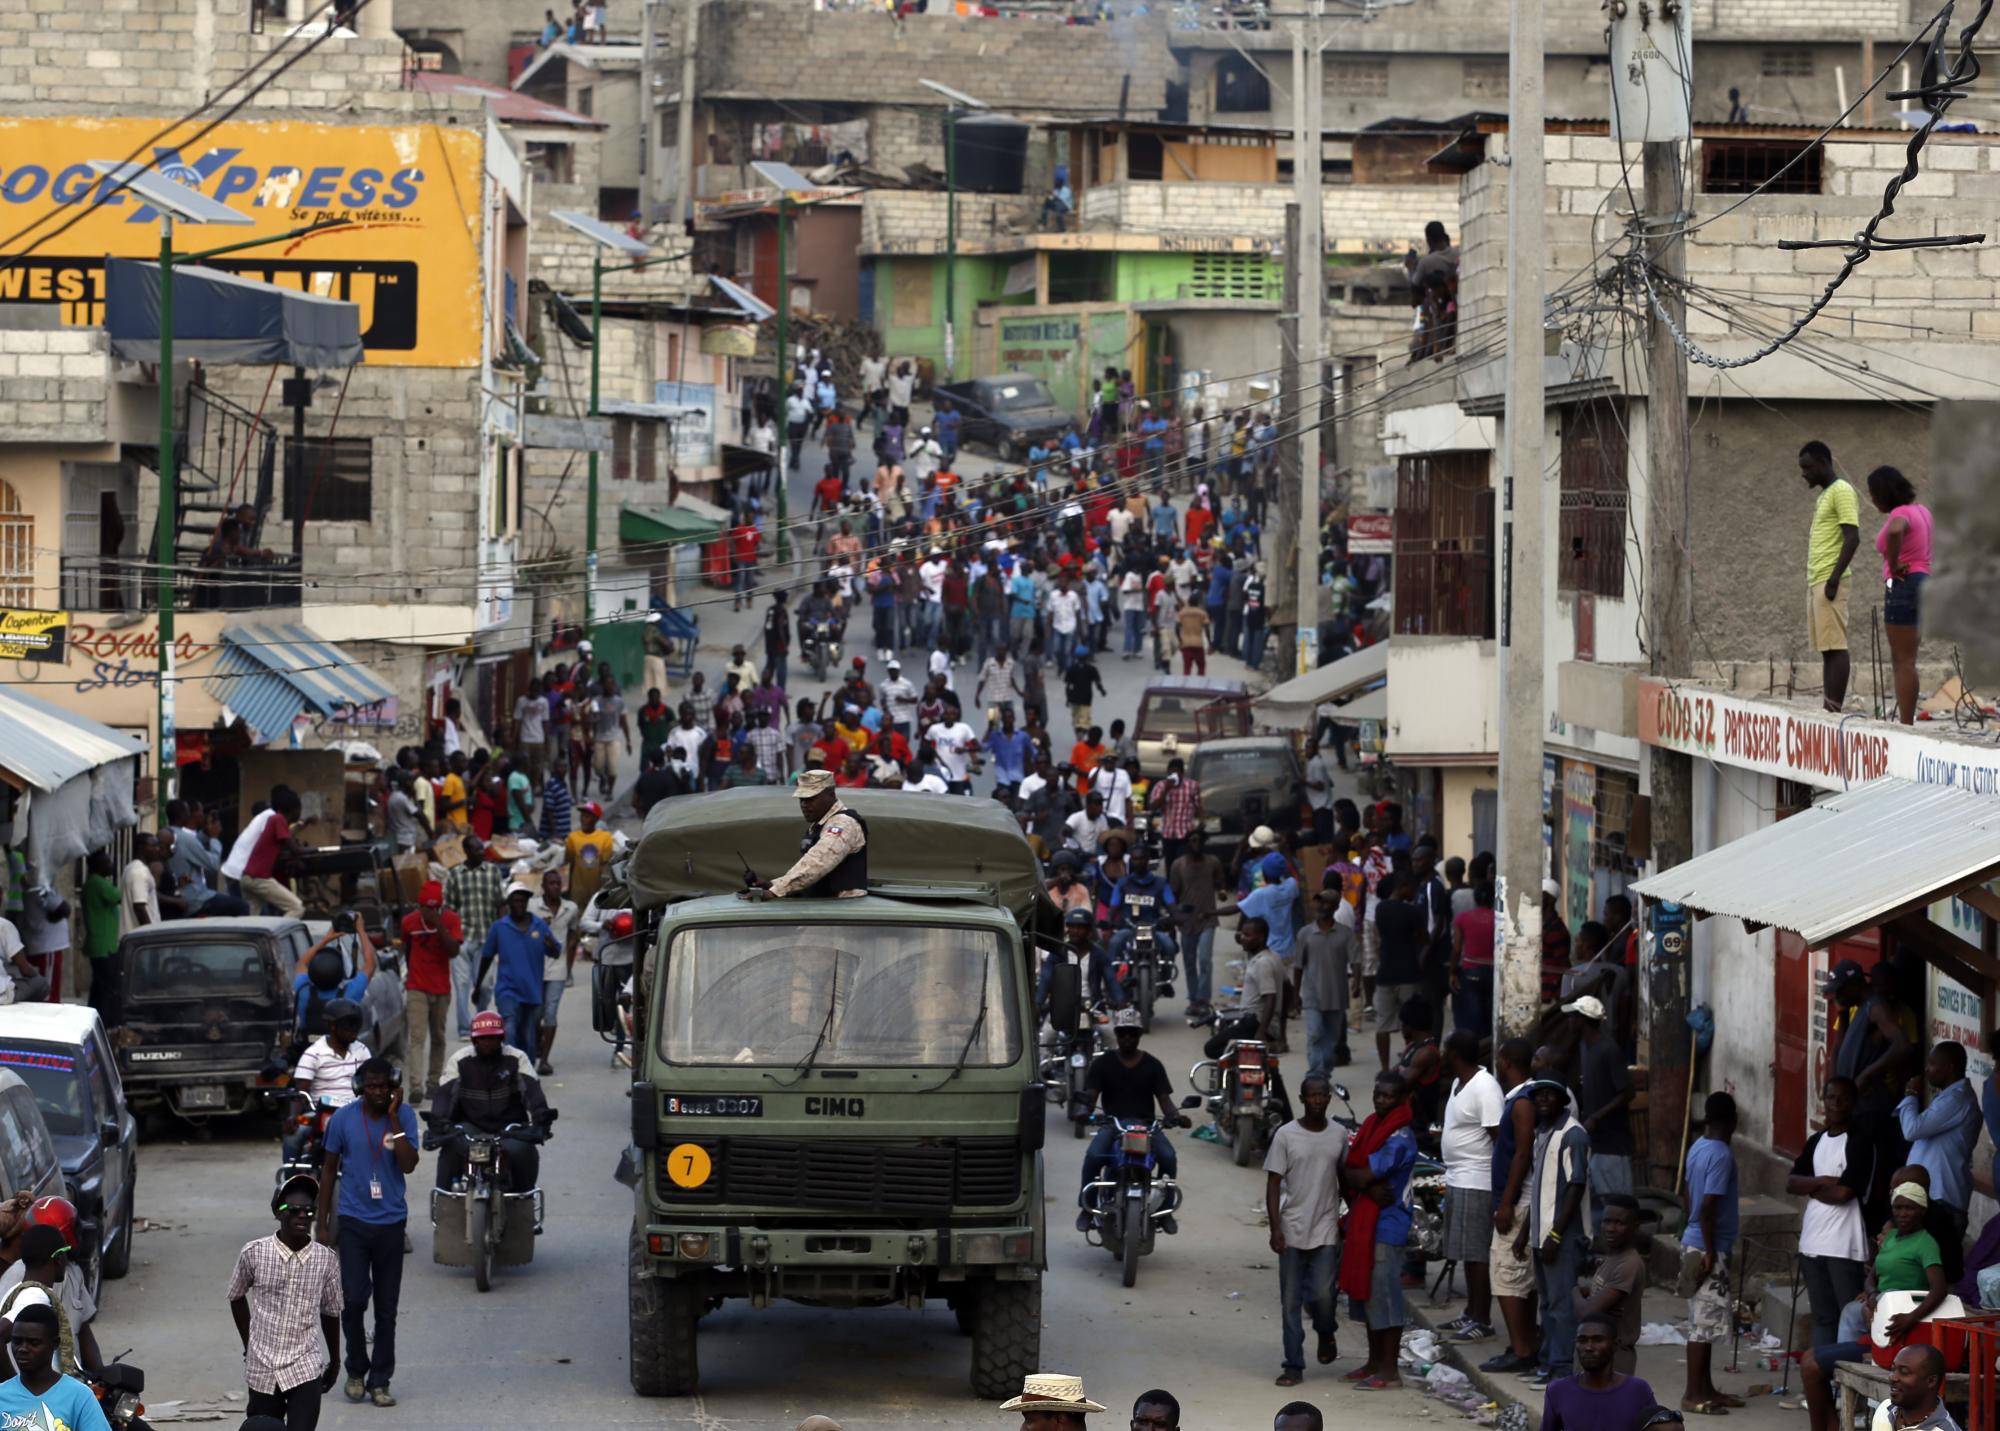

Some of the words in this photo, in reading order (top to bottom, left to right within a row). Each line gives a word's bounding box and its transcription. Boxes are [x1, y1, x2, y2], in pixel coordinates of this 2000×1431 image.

[1695, 697, 1716, 747] 32
[1724, 707, 1781, 764] PATISSERIE
[1664, 937, 1681, 948] 69
[132, 1052, 182, 1061] SUZUKI
[683, 1156, 694, 1176] 7
[1, 1411, 38, 1429] Don't
